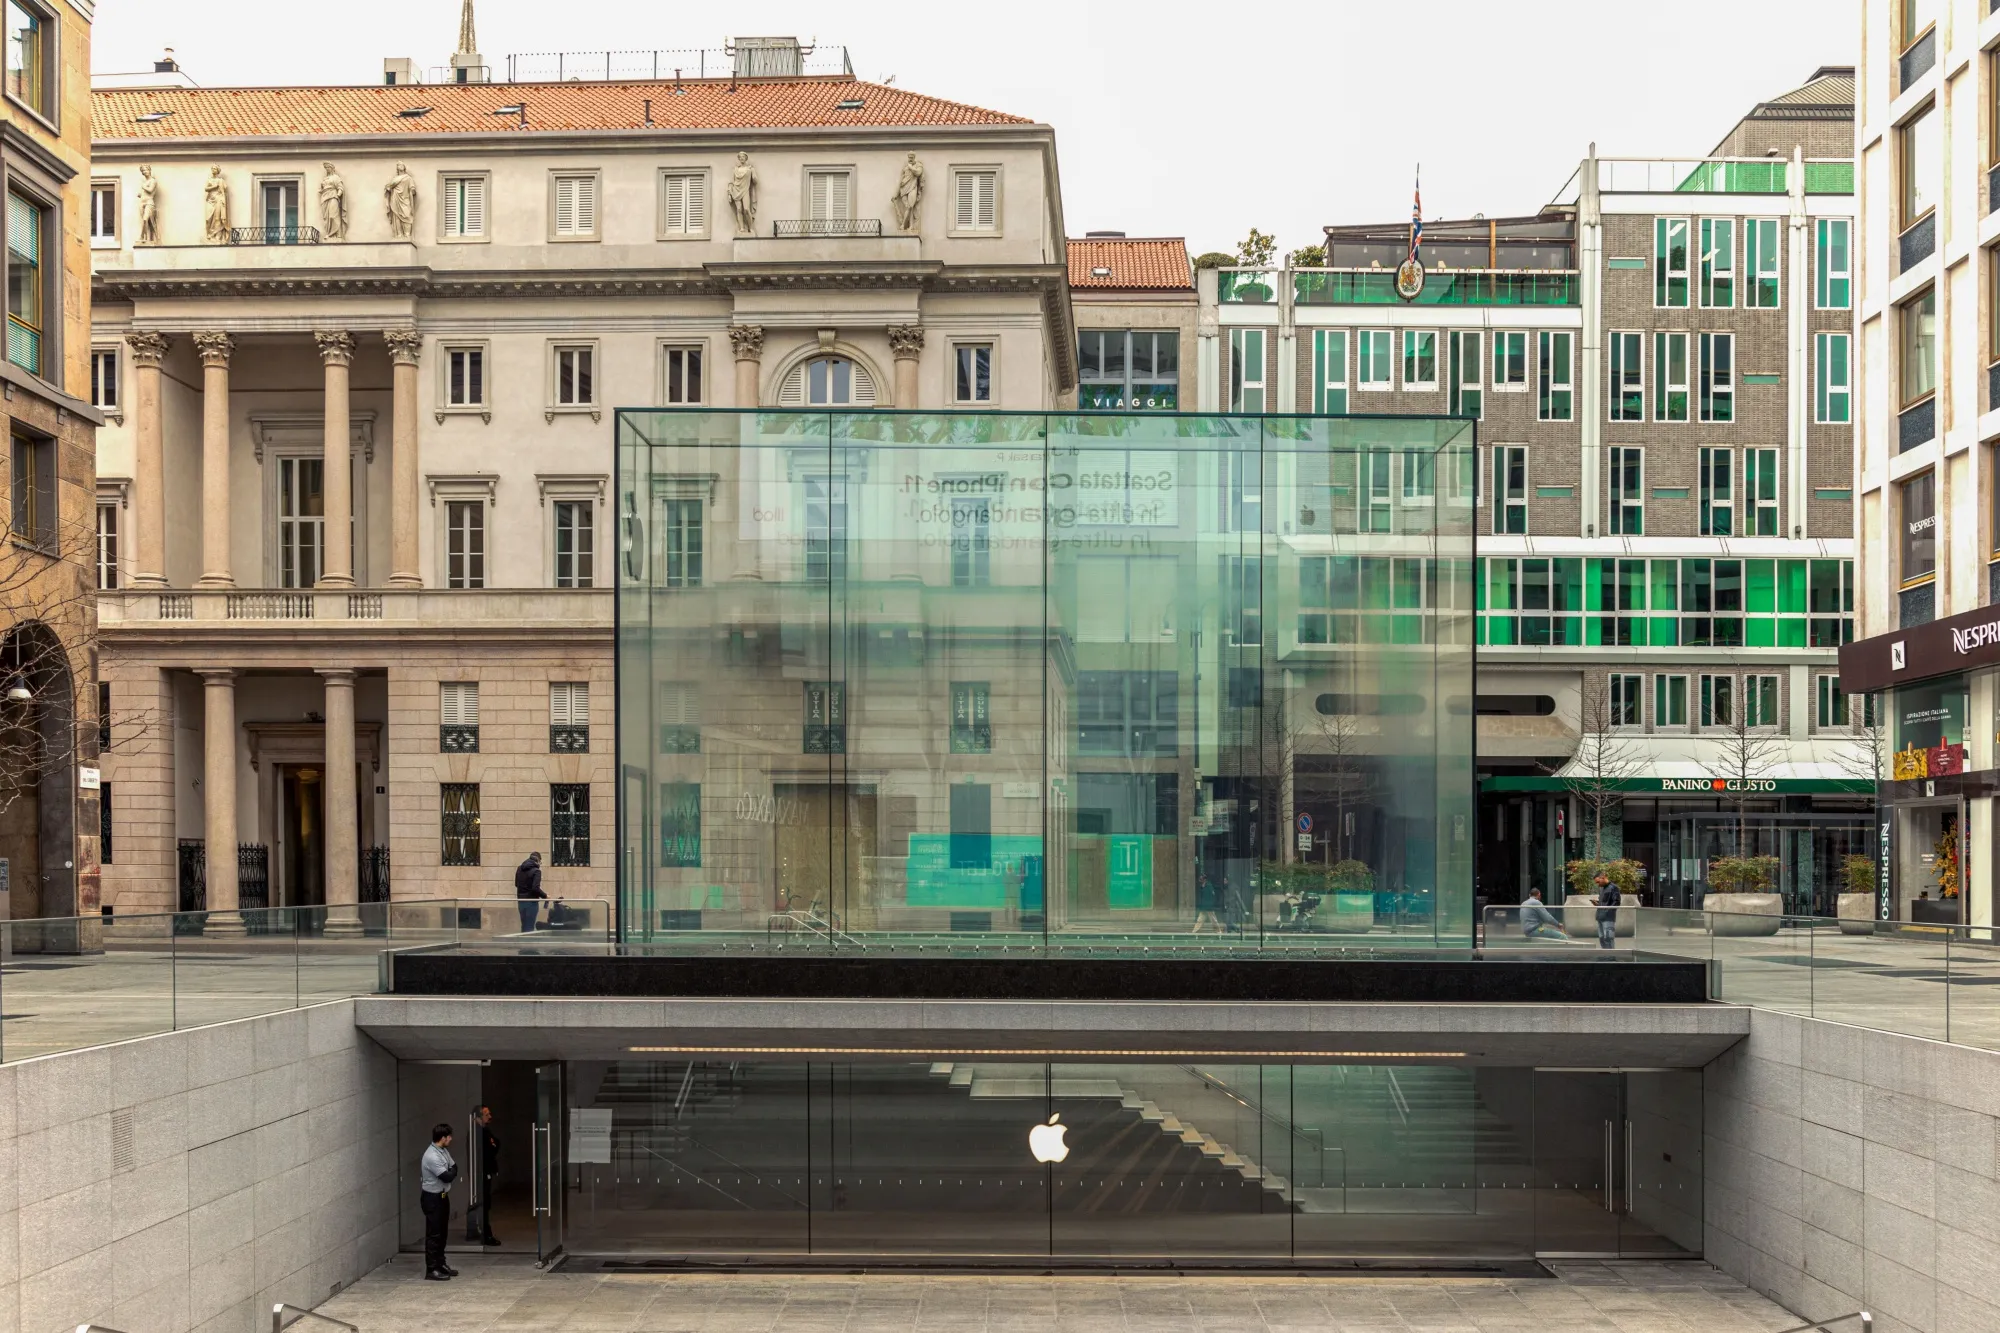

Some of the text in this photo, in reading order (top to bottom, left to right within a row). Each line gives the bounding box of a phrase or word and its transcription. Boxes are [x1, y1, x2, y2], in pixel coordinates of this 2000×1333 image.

[1093, 398, 1168, 407] VIAGGI
[1909, 515, 1935, 534] NESPRES
[1662, 779, 1711, 791] PANINO
[1880, 820, 1891, 920] NESPRESSO
